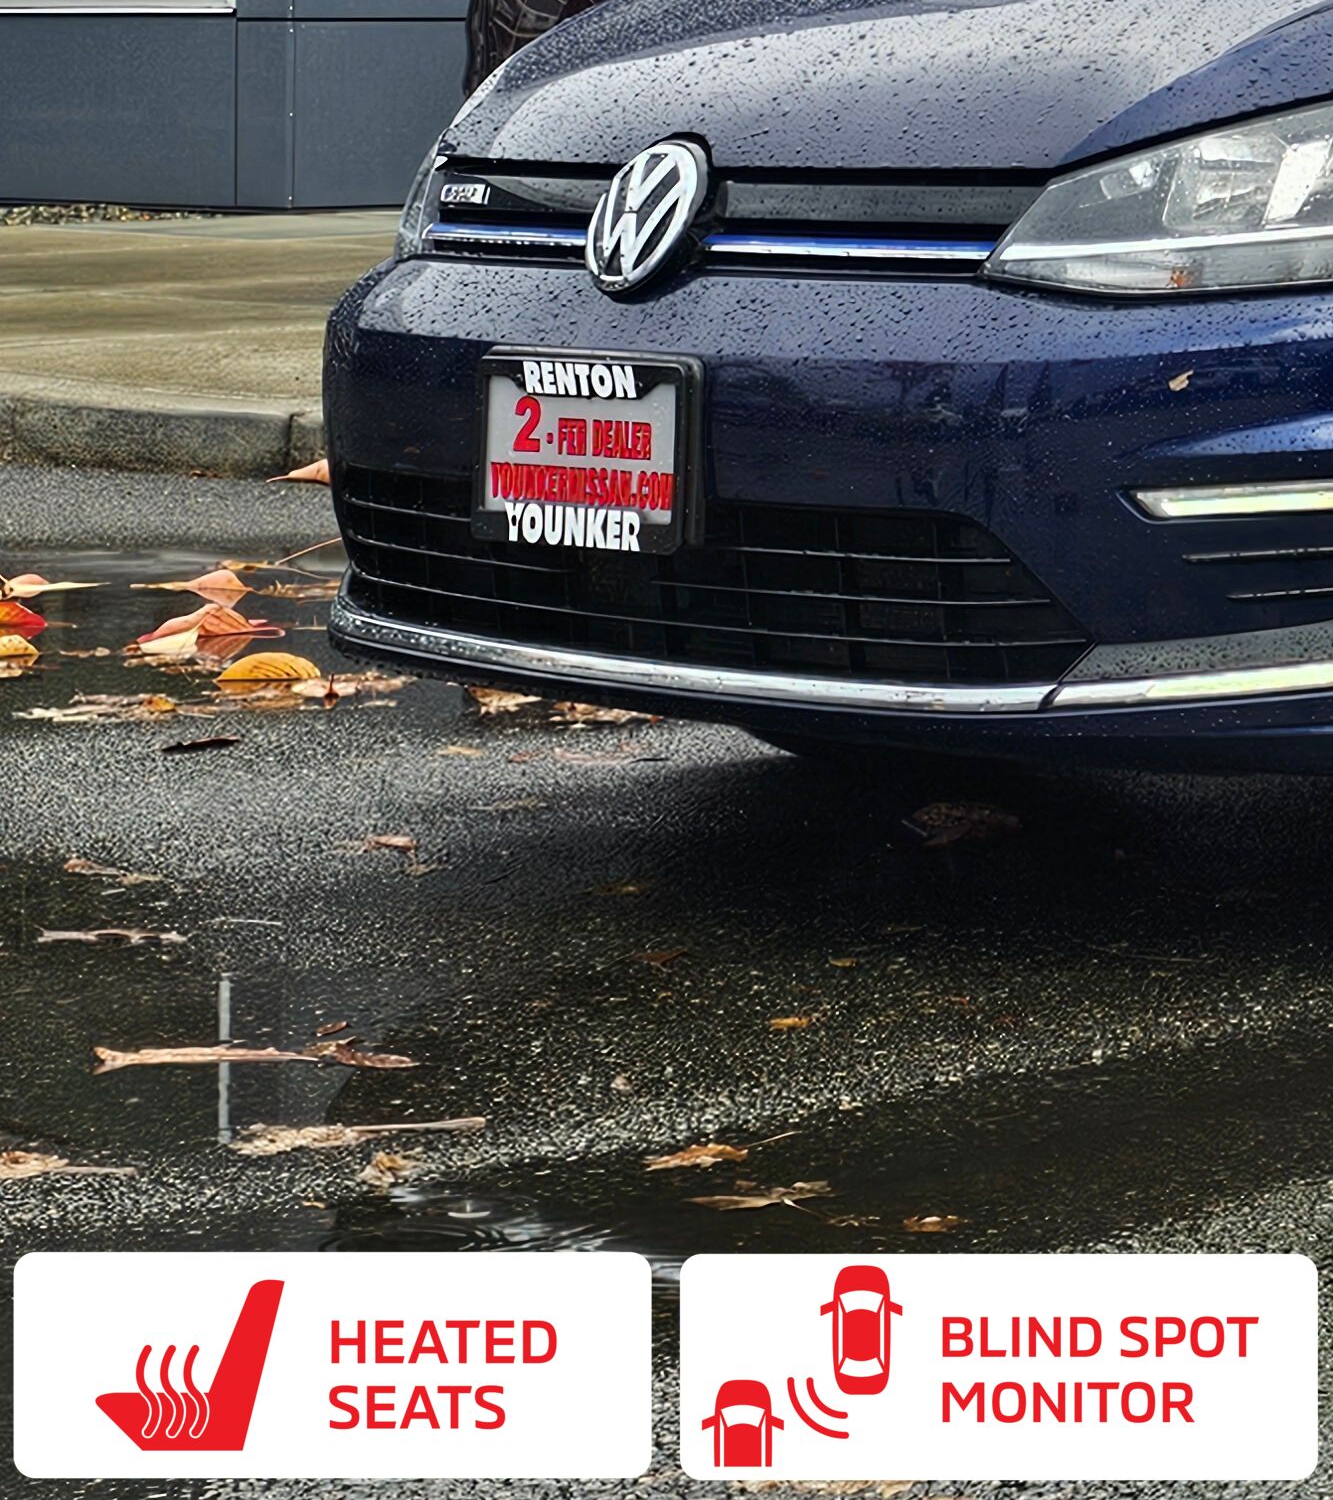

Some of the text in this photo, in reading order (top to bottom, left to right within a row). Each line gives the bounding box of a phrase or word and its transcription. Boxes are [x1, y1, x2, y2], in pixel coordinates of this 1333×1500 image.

[522, 361, 637, 398] RENTON
[592, 419, 652, 460] DEALER
[504, 501, 641, 552] YOUNKER
